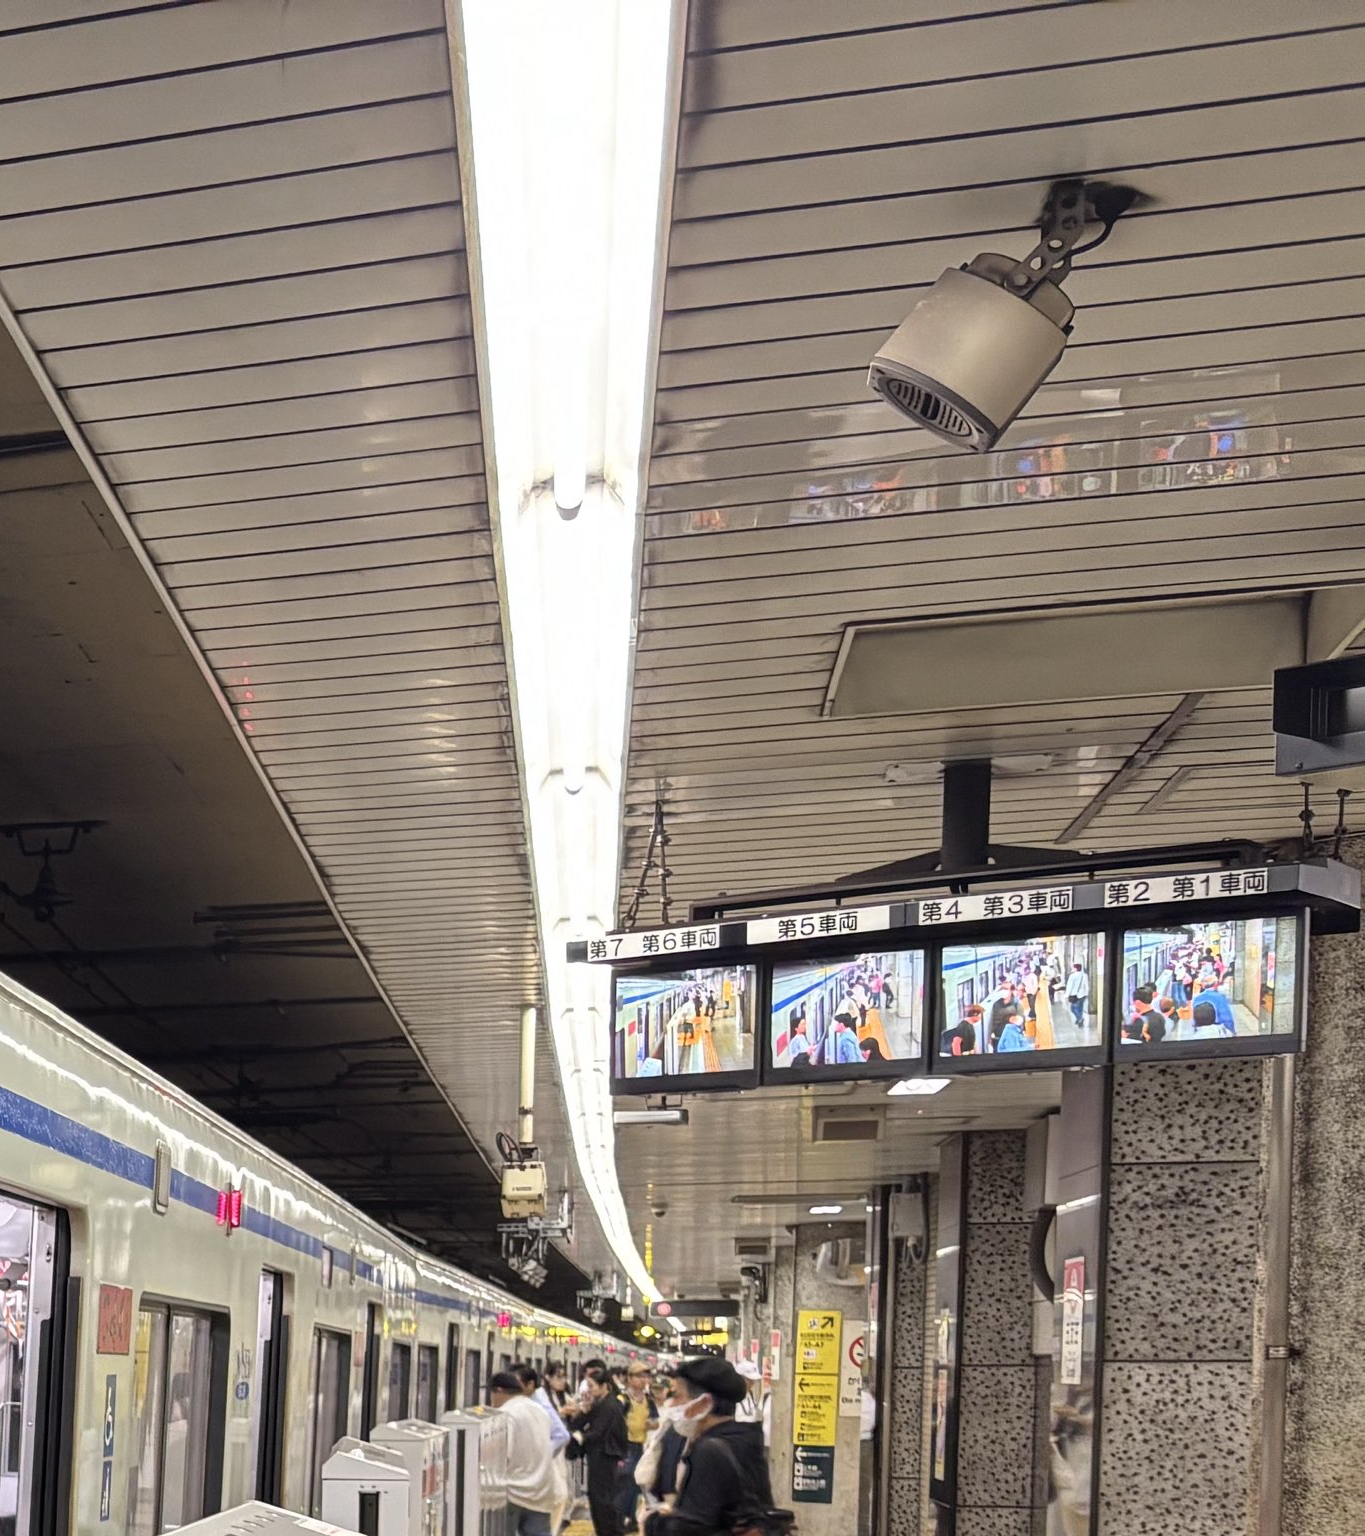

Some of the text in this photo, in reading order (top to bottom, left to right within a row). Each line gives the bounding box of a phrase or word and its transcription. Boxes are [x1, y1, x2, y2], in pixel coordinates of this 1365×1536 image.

[1107, 870, 1267, 906] 第2 第1車両
[921, 888, 1072, 923] 第4 第3車両
[778, 911, 859, 939] 第5車両
[589, 927, 718, 960] 第7 第6車両
